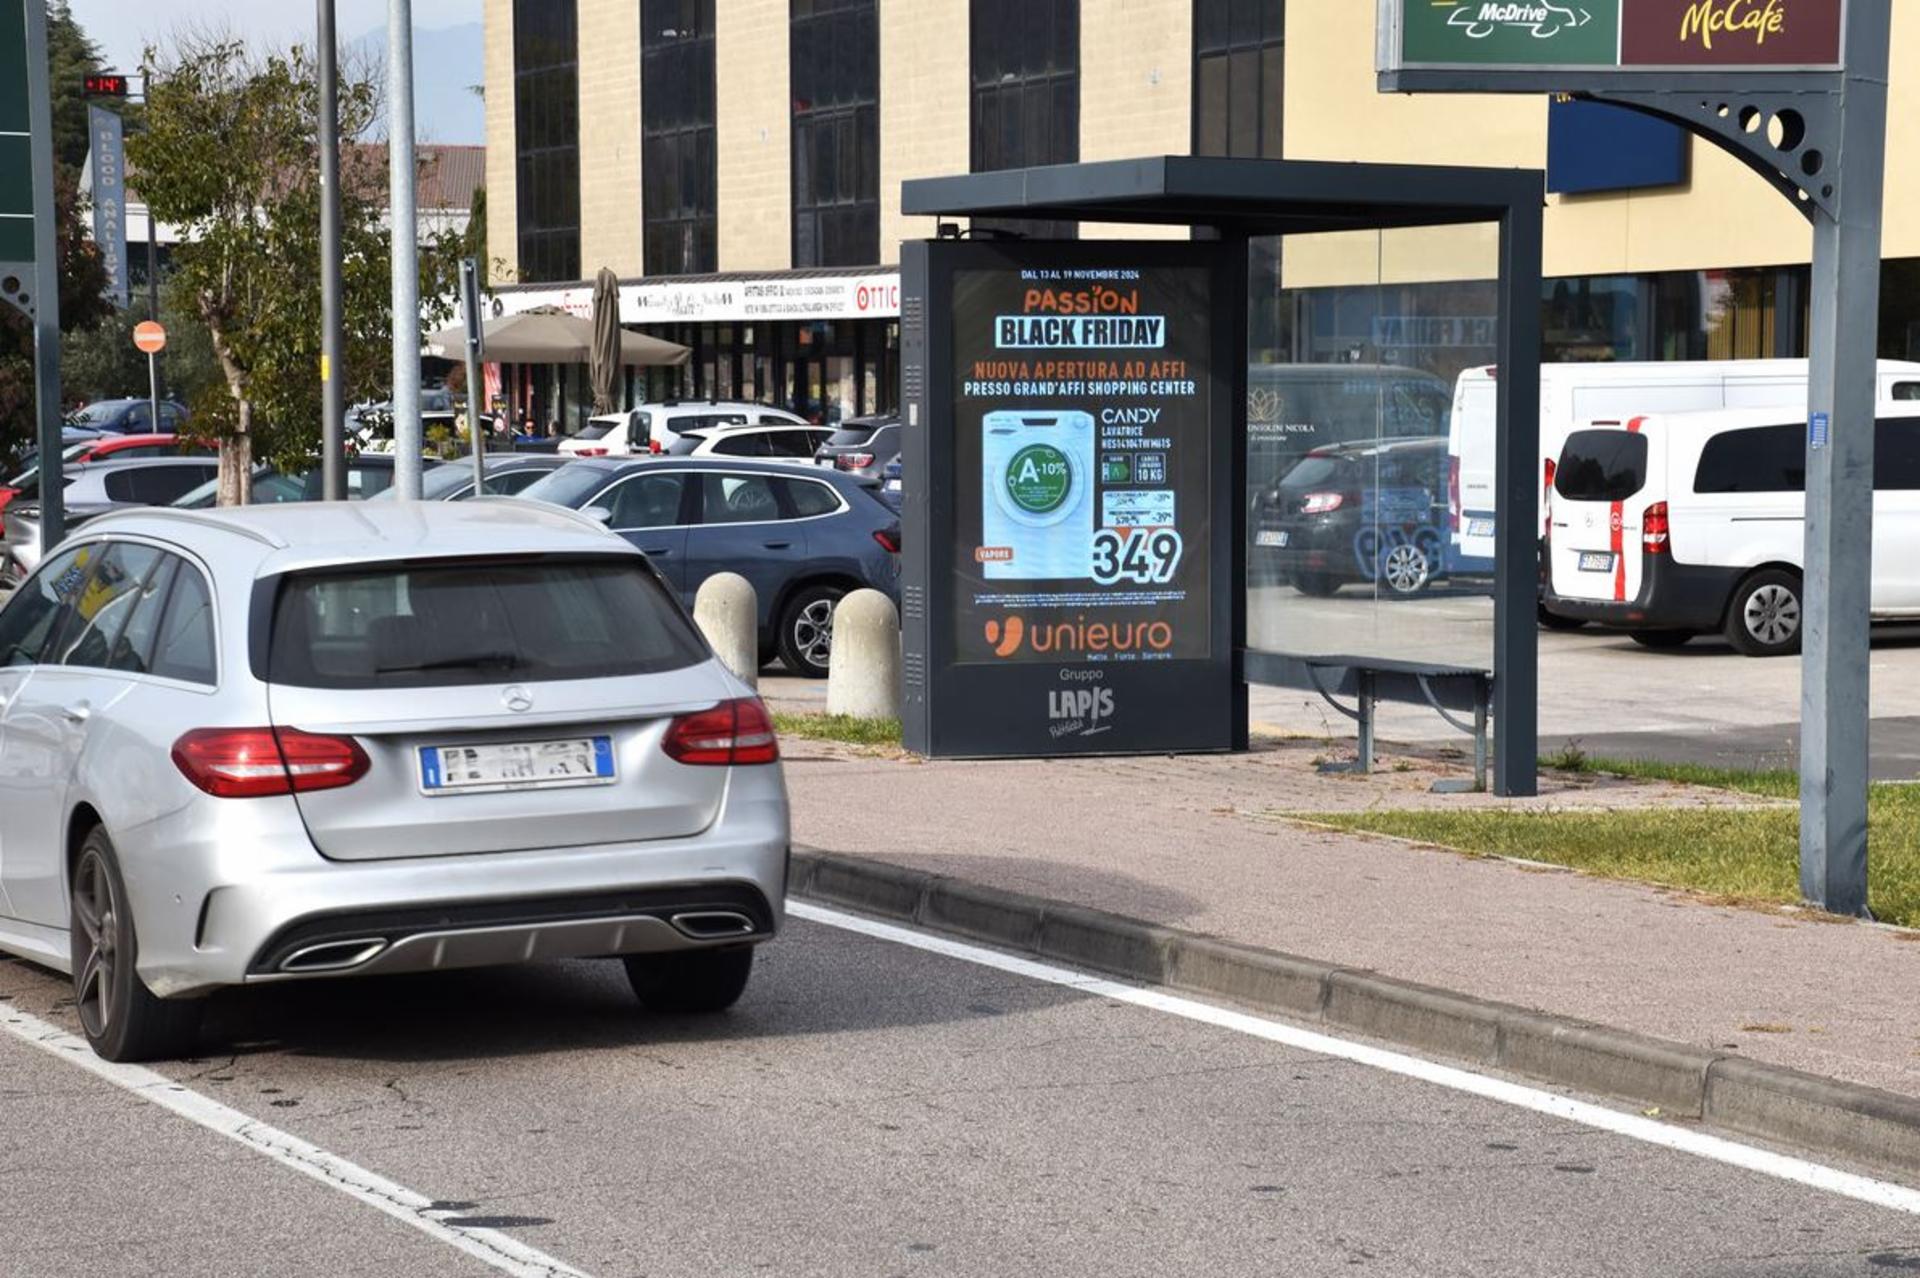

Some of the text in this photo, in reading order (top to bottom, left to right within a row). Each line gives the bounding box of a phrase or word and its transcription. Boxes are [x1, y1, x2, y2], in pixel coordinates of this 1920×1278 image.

[1478, 3, 1548, 22] McDrive
[1680, 0, 1783, 49] McCafé
[1021, 270, 1038, 279] DAL
[1040, 270, 1049, 279] 13
[1050, 270, 1061, 279] AL
[1073, 270, 1119, 279] NOVEMBRE
[1121, 270, 1140, 279] 2024
[1000, 318, 1162, 346] BLACK FRIDAY
[975, 360, 1186, 380] NUOVA APERTURA AD AFFI
[964, 380, 1196, 397] PRESSO GRAND'AFFI SHOPPING CENTER
[1101, 408, 1161, 424] CANDY
[1101, 427, 1144, 437] LAVATRICE
[1138, 469, 1163, 480] 10 KG
[1092, 530, 1180, 582] 349
[1031, 616, 1173, 652] unieuro
[1059, 668, 1104, 682] Gruppo
[1049, 687, 1115, 720] LAPIS
